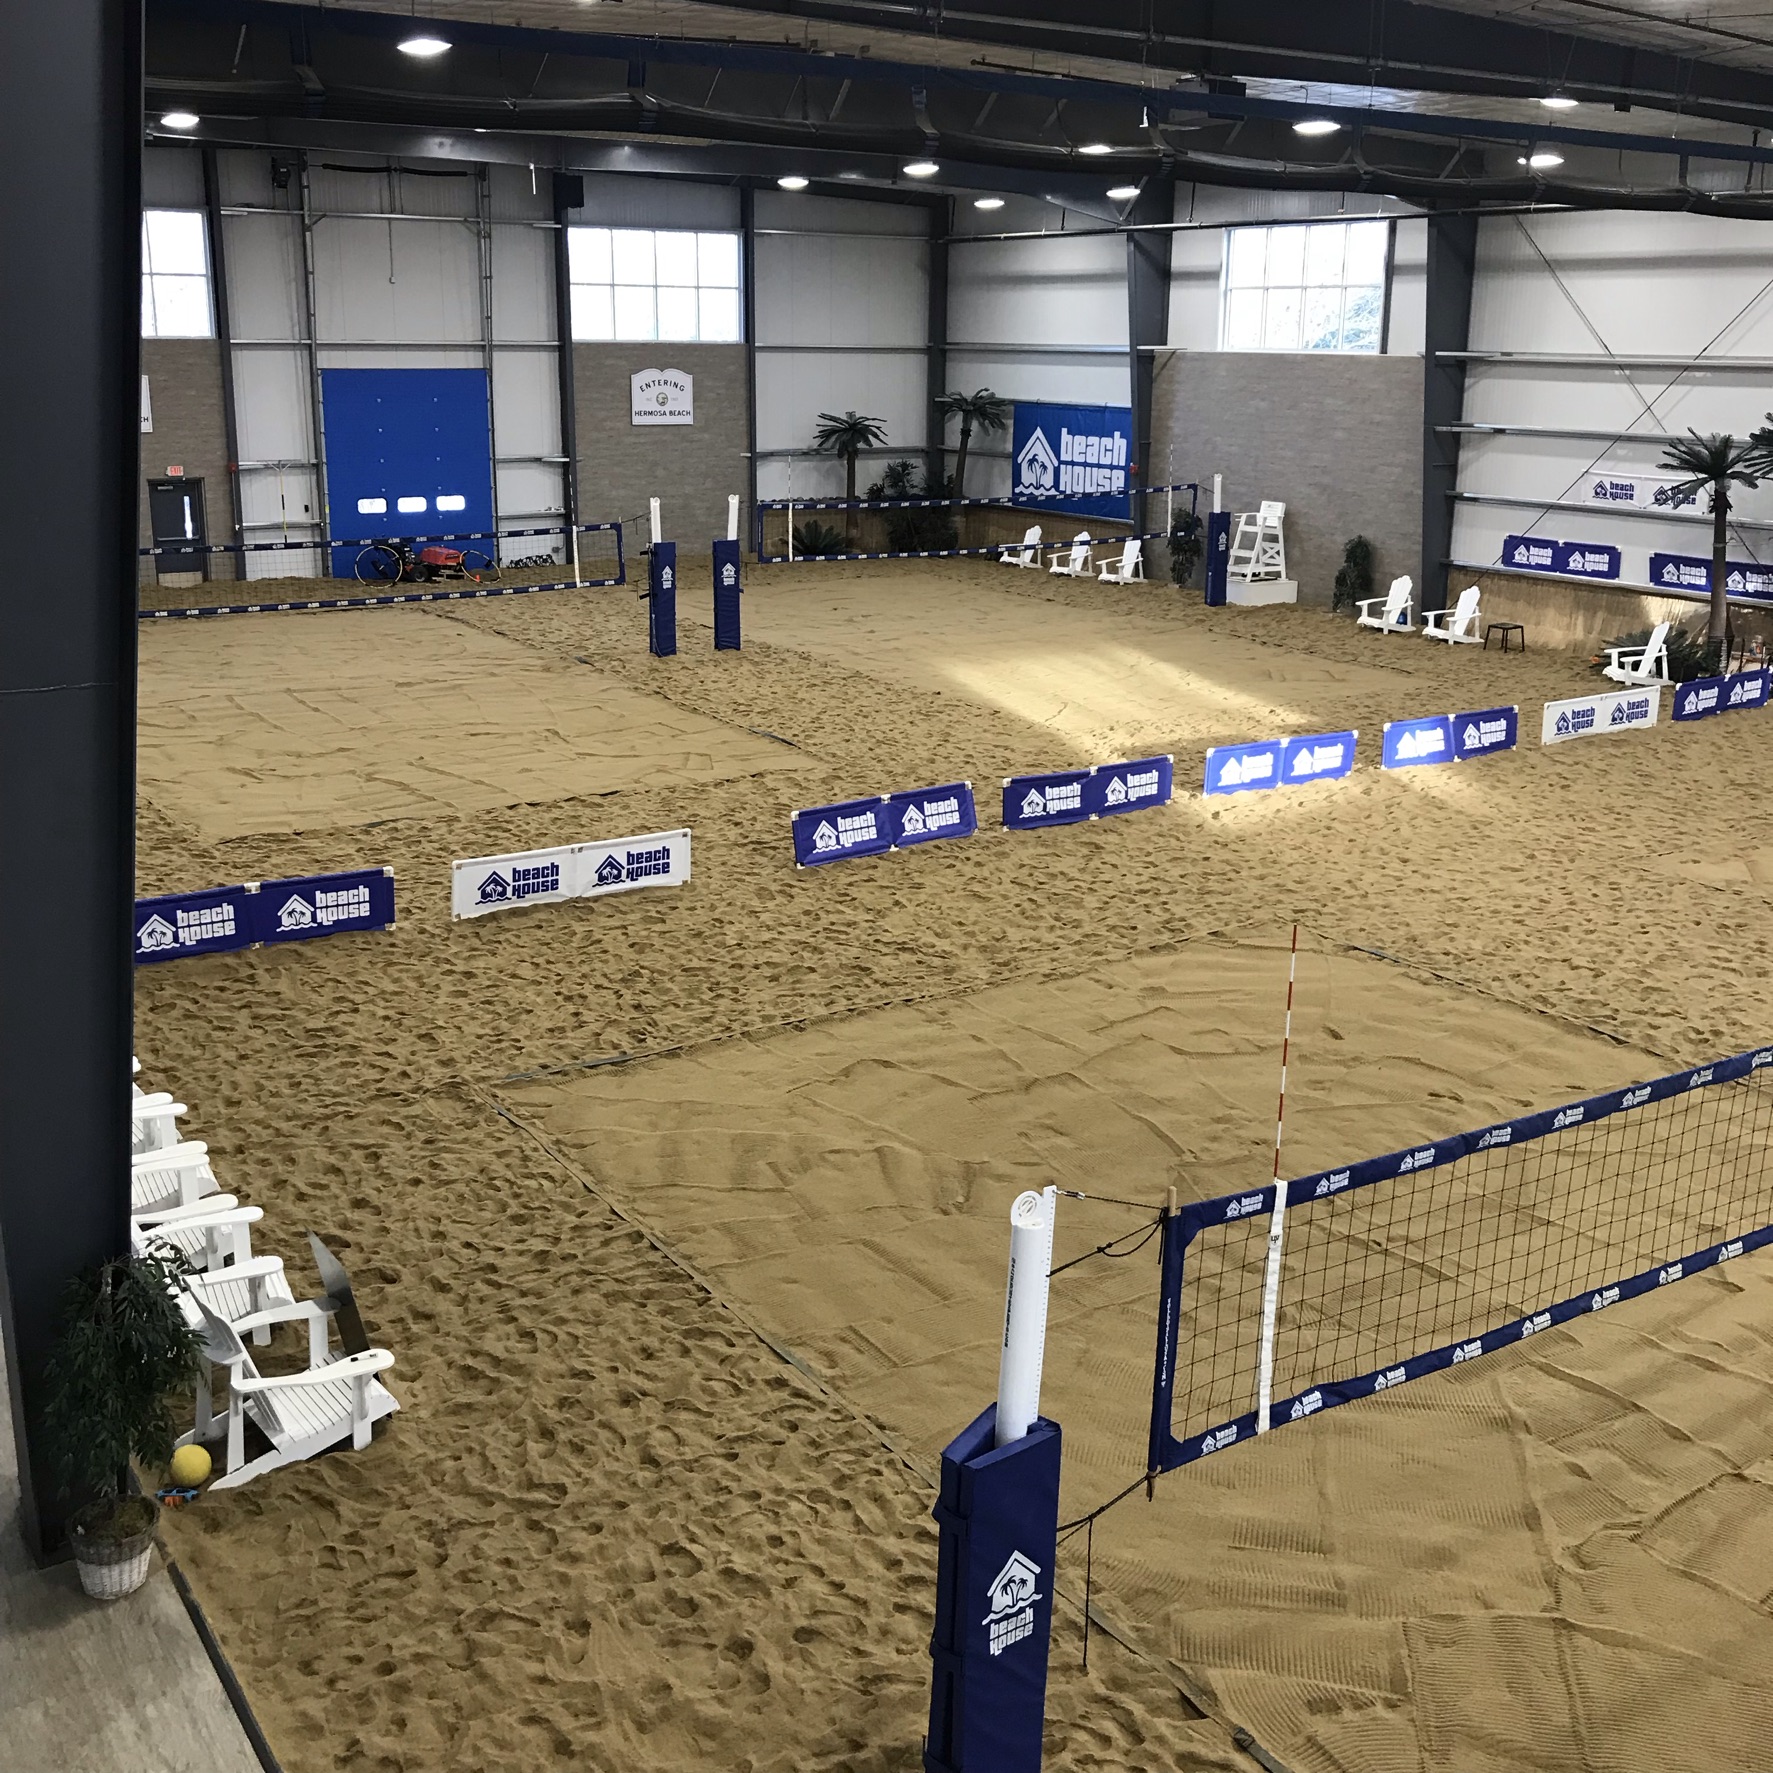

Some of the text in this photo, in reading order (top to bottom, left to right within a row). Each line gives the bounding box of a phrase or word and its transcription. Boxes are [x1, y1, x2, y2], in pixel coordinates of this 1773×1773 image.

[640, 379, 685, 392] ENTERING
[1060, 428, 1127, 466] beach
[1610, 481, 1634, 492] beach
[1530, 545, 1552, 557] beach
[1585, 552, 1609, 564] beach
[1680, 564, 1706, 577] beach
[1627, 698, 1649, 710] beach
[1572, 706, 1595, 720] beach
[1480, 718, 1507, 734] beach
[1127, 770, 1159, 787] beach
[1045, 782, 1081, 800] beach
[924, 797, 959, 816] beach
[837, 811, 876, 832] beach
[626, 846, 670, 866] beach
[512, 862, 560, 883] beach
[315, 884, 370, 907] beach
[176, 902, 235, 927] beach
[990, 1606, 1034, 1640] beach
